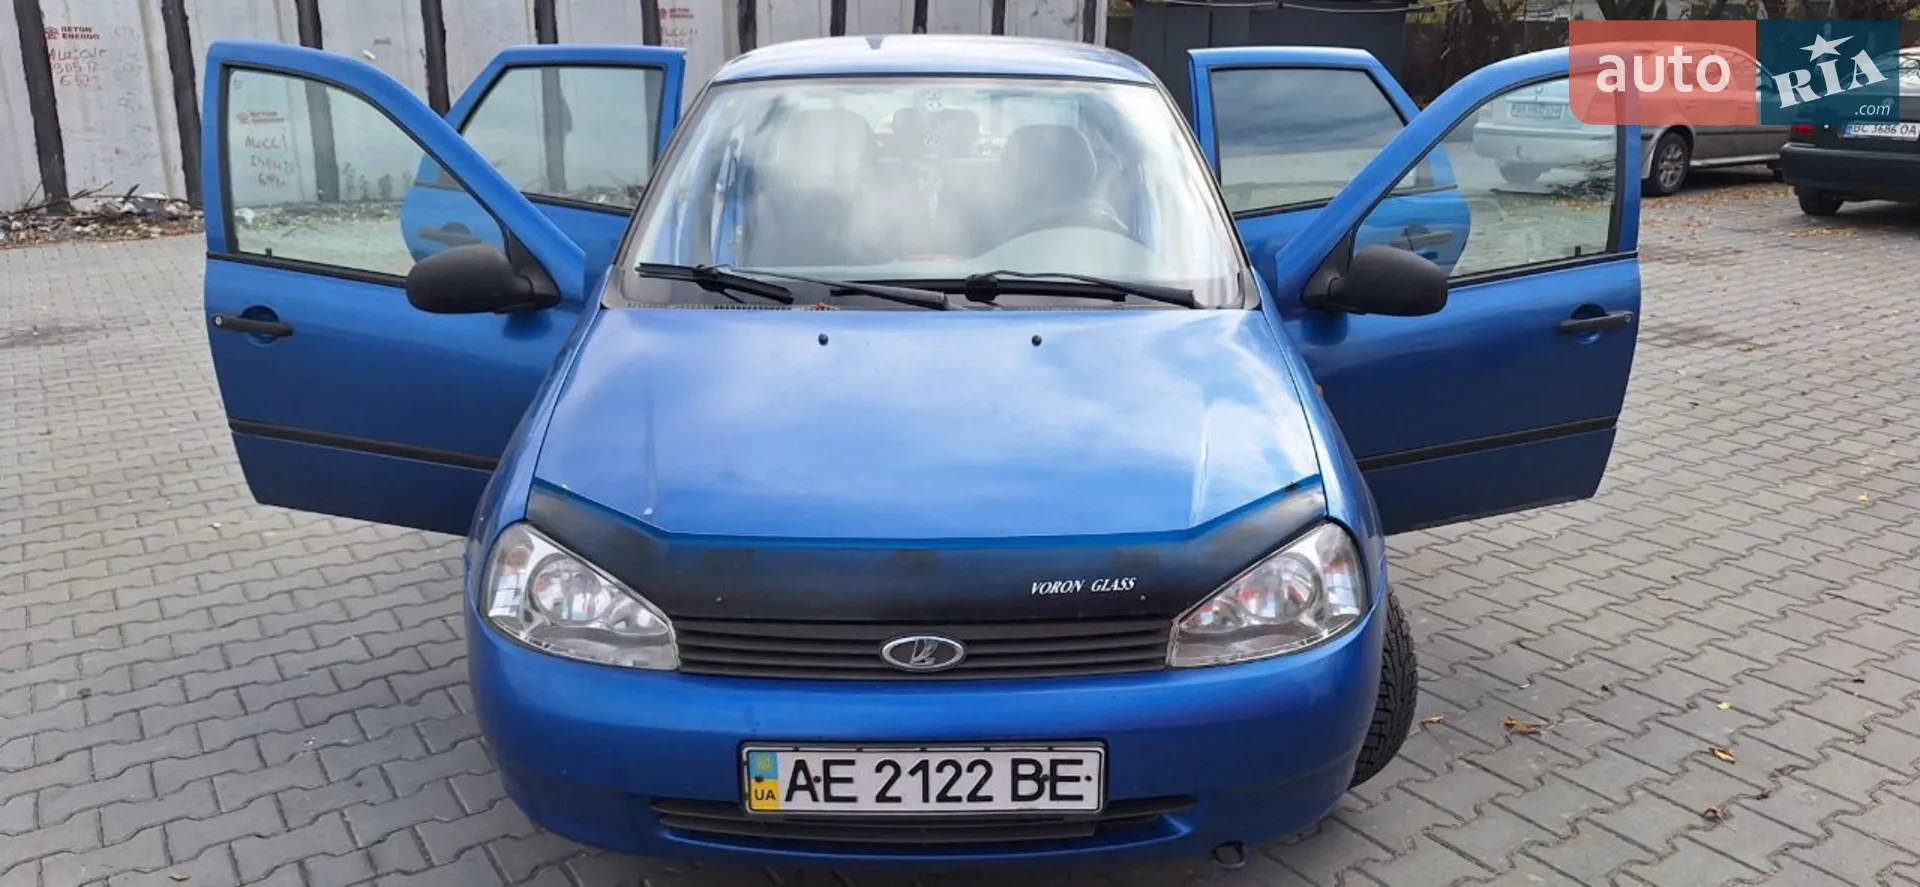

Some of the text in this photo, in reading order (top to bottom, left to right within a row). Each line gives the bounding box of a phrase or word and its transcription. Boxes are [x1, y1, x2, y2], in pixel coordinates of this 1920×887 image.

[1031, 577, 1137, 595] VORON GLASS
[784, 758, 1085, 803] AE 2122 BE
[754, 789, 776, 801] UA
